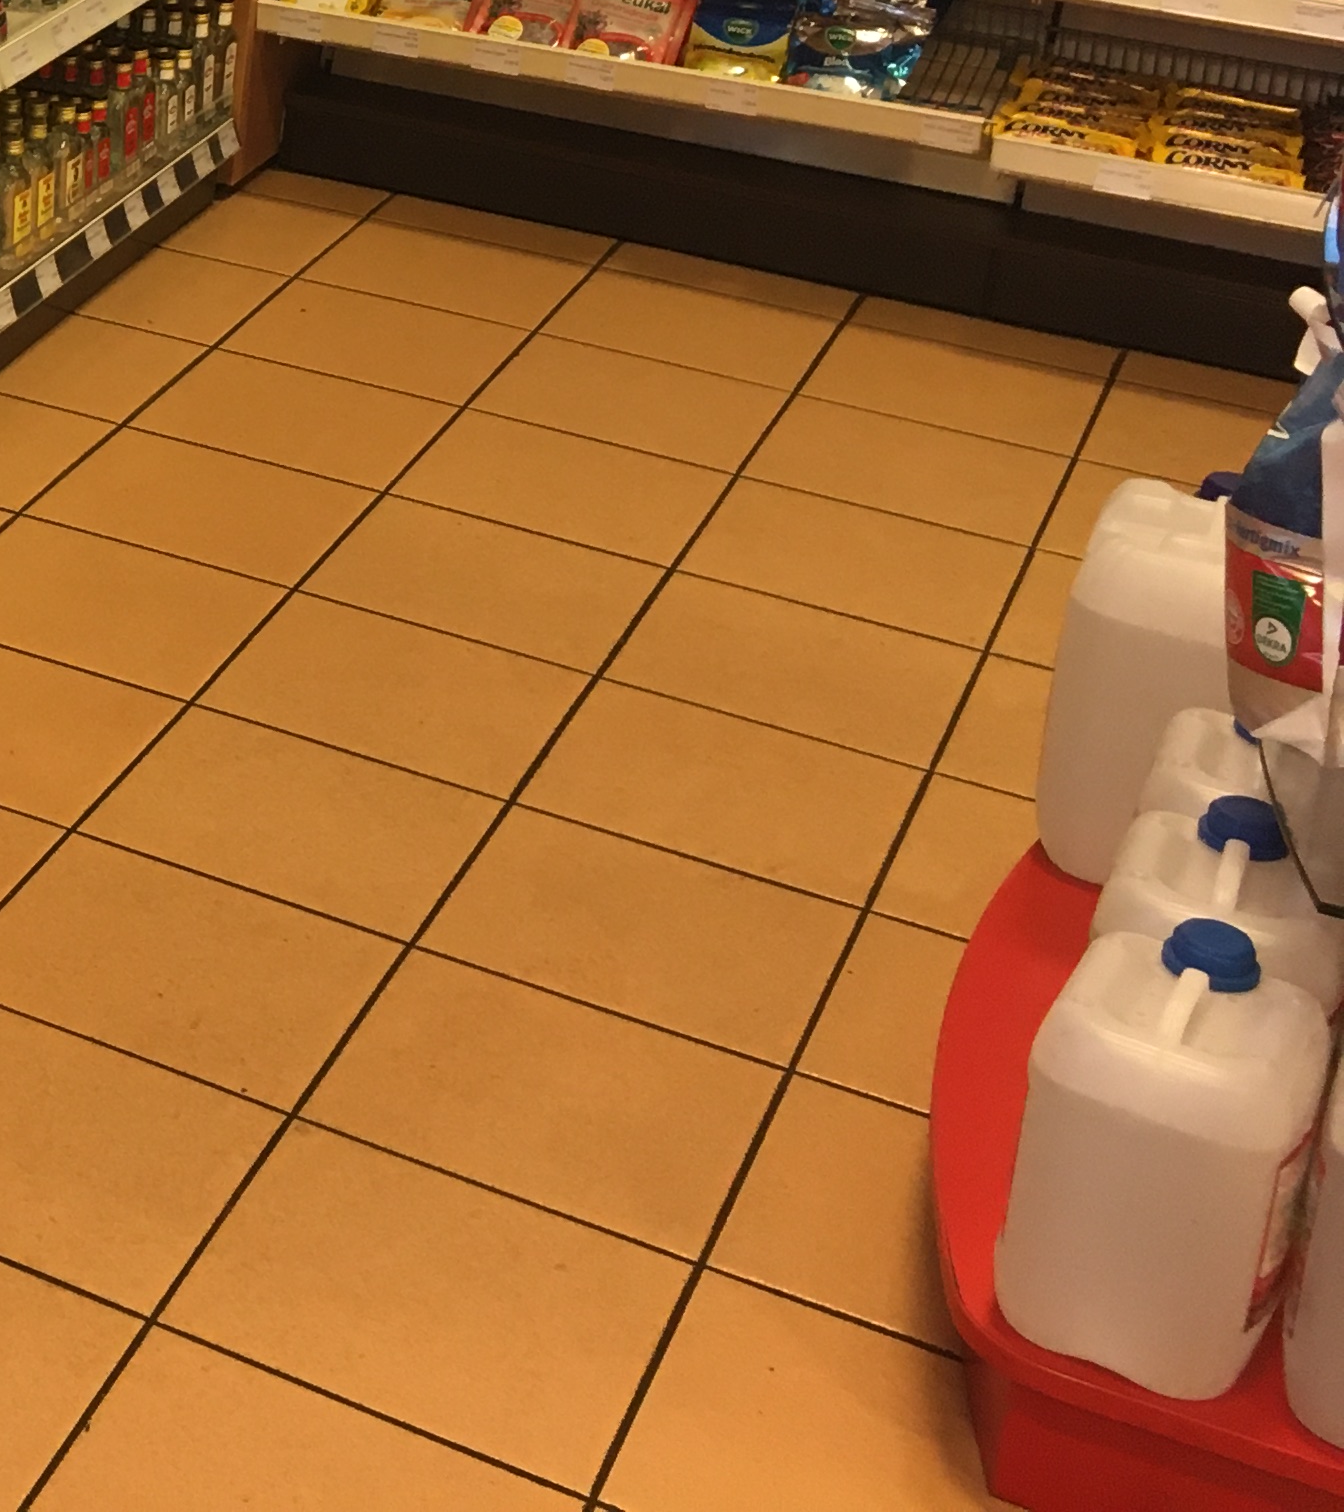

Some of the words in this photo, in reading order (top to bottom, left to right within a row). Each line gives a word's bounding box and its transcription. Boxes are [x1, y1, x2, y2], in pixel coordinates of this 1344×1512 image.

[726, 24, 752, 36] WICK
[1004, 120, 1086, 140] CORNY
[1166, 133, 1251, 155] CORNY
[1165, 150, 1252, 172] CORNY
